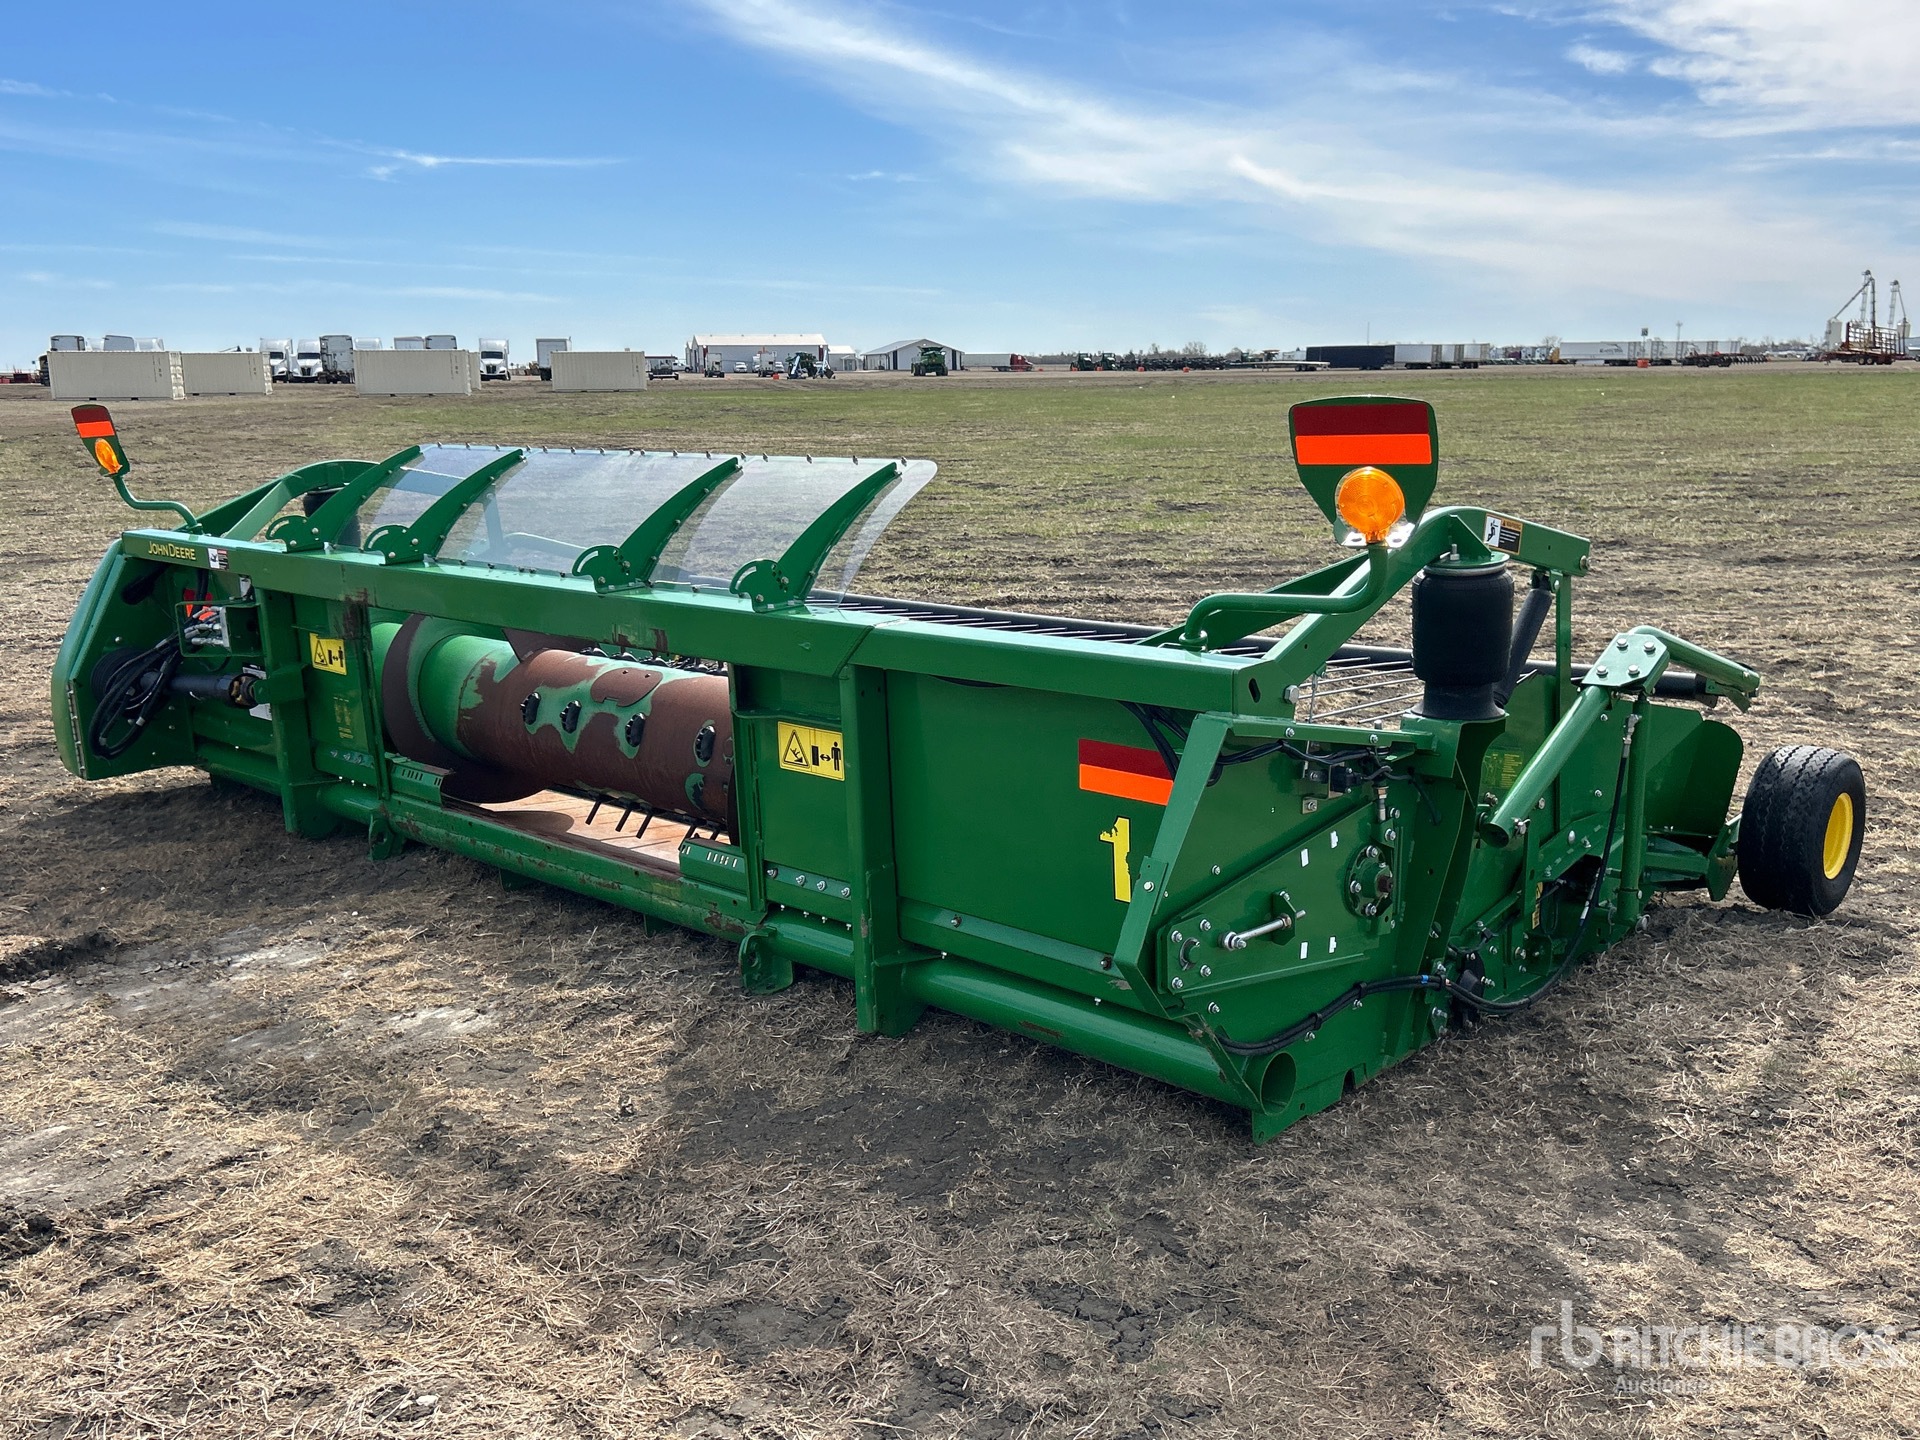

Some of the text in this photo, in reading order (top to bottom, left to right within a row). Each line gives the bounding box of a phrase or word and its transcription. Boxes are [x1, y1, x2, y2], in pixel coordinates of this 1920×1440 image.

[148, 541, 196, 560] JOHN DEERE
[1099, 816, 1131, 904] 1
